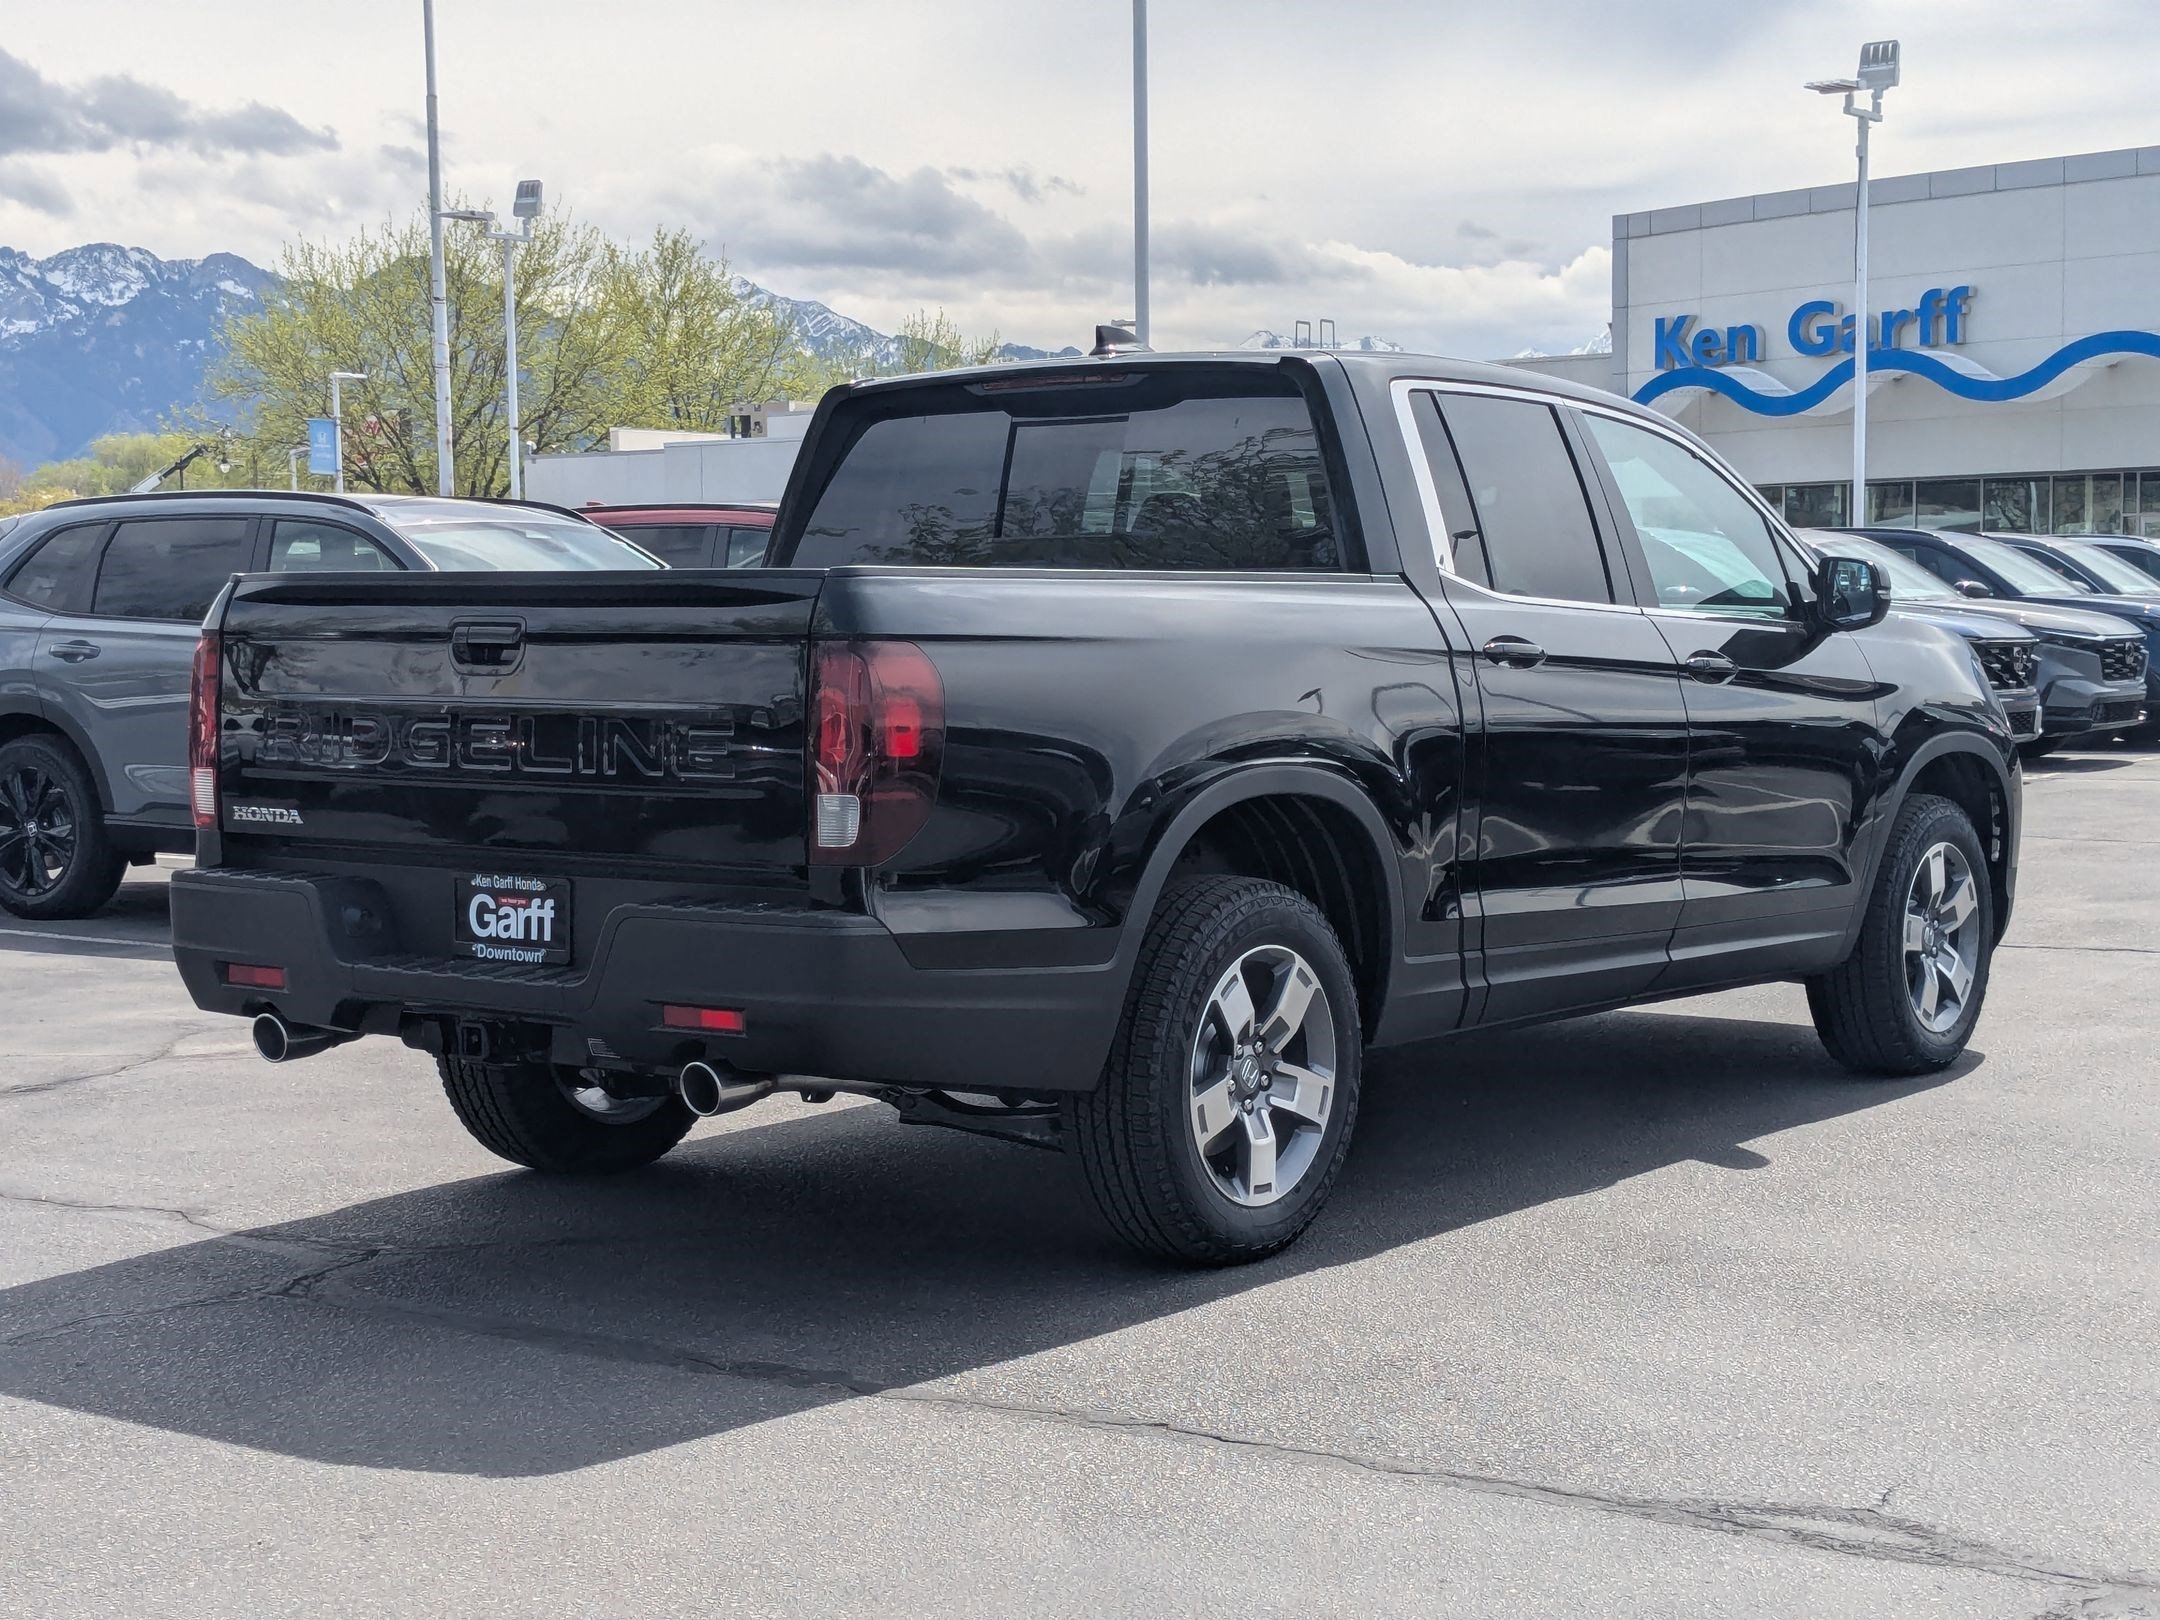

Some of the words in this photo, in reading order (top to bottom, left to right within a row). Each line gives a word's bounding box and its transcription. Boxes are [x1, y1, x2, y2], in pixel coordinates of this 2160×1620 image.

[1654, 314, 1762, 370] Ken
[1788, 285, 1971, 356] Garff
[257, 706, 736, 779] RIDGELINE
[233, 806, 304, 824] HONDA
[475, 873, 492, 887] Ken
[493, 875, 513, 889] Garff
[469, 893, 555, 941] Garff
[477, 944, 543, 963] Downtown
